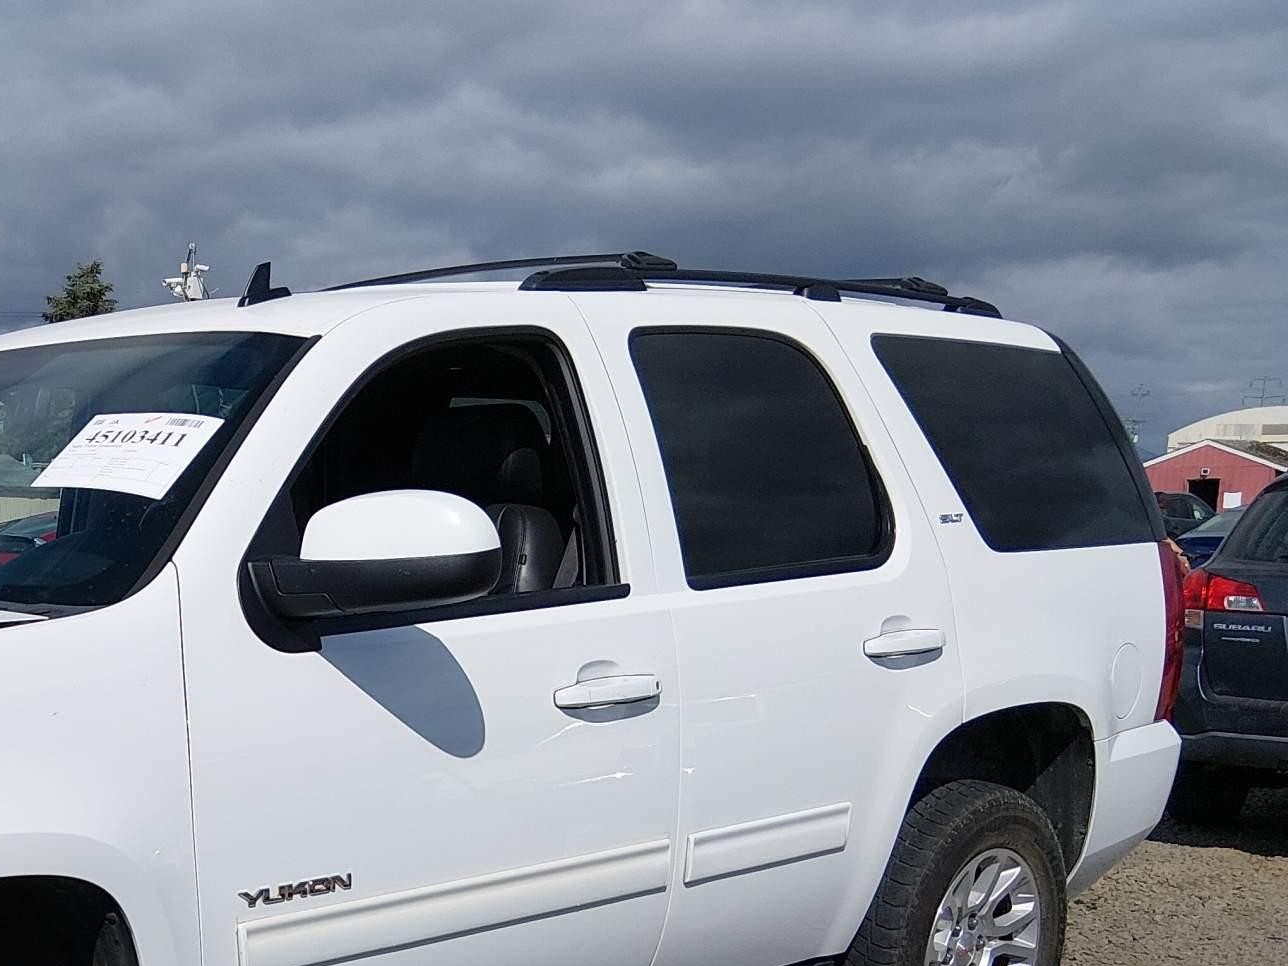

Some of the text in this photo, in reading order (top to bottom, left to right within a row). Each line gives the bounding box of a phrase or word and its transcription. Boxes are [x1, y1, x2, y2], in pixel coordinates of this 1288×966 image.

[85, 430, 188, 448] 45103411
[1213, 623, 1272, 633] SUBARU
[237, 872, 352, 908] YUKON
